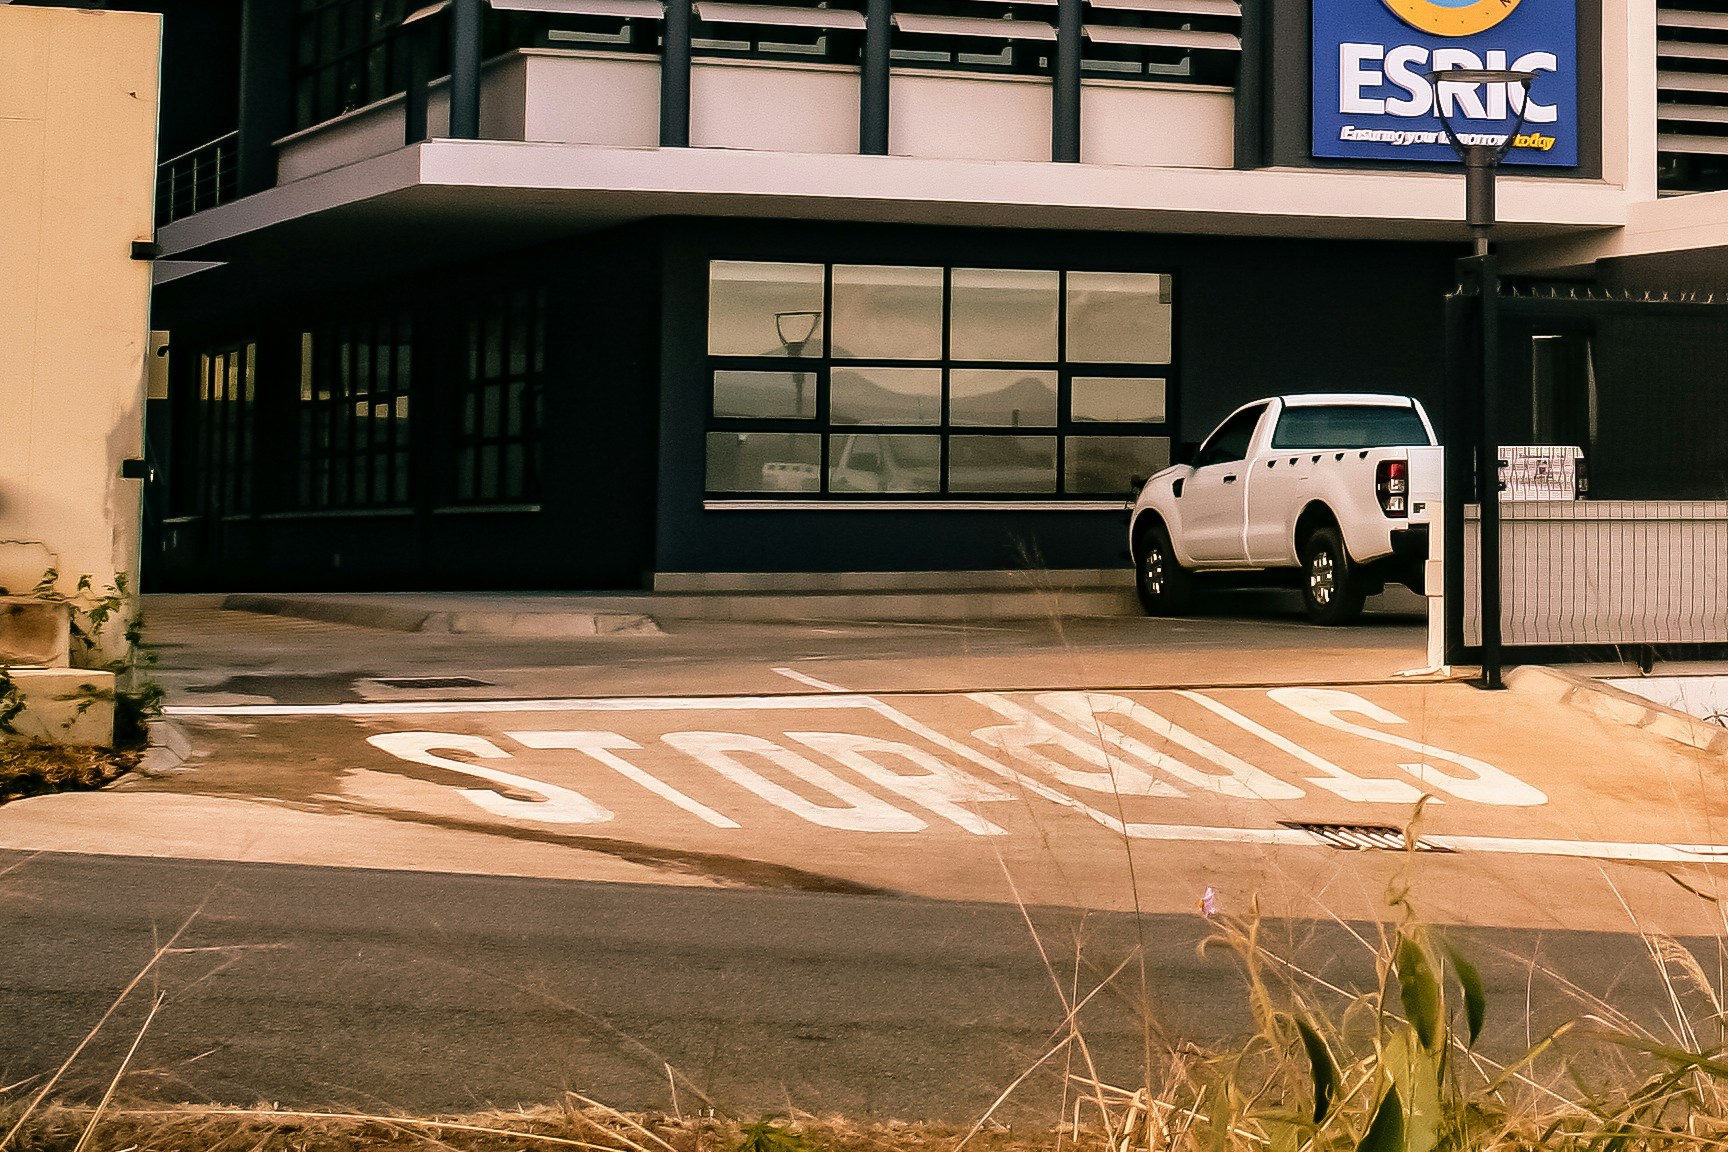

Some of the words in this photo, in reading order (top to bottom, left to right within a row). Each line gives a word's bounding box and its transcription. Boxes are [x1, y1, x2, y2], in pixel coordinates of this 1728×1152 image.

[1339, 42, 1558, 123] ESRIC
[1512, 132, 1556, 151] today
[366, 730, 1019, 836] STOP
[964, 689, 1549, 806] STOP
